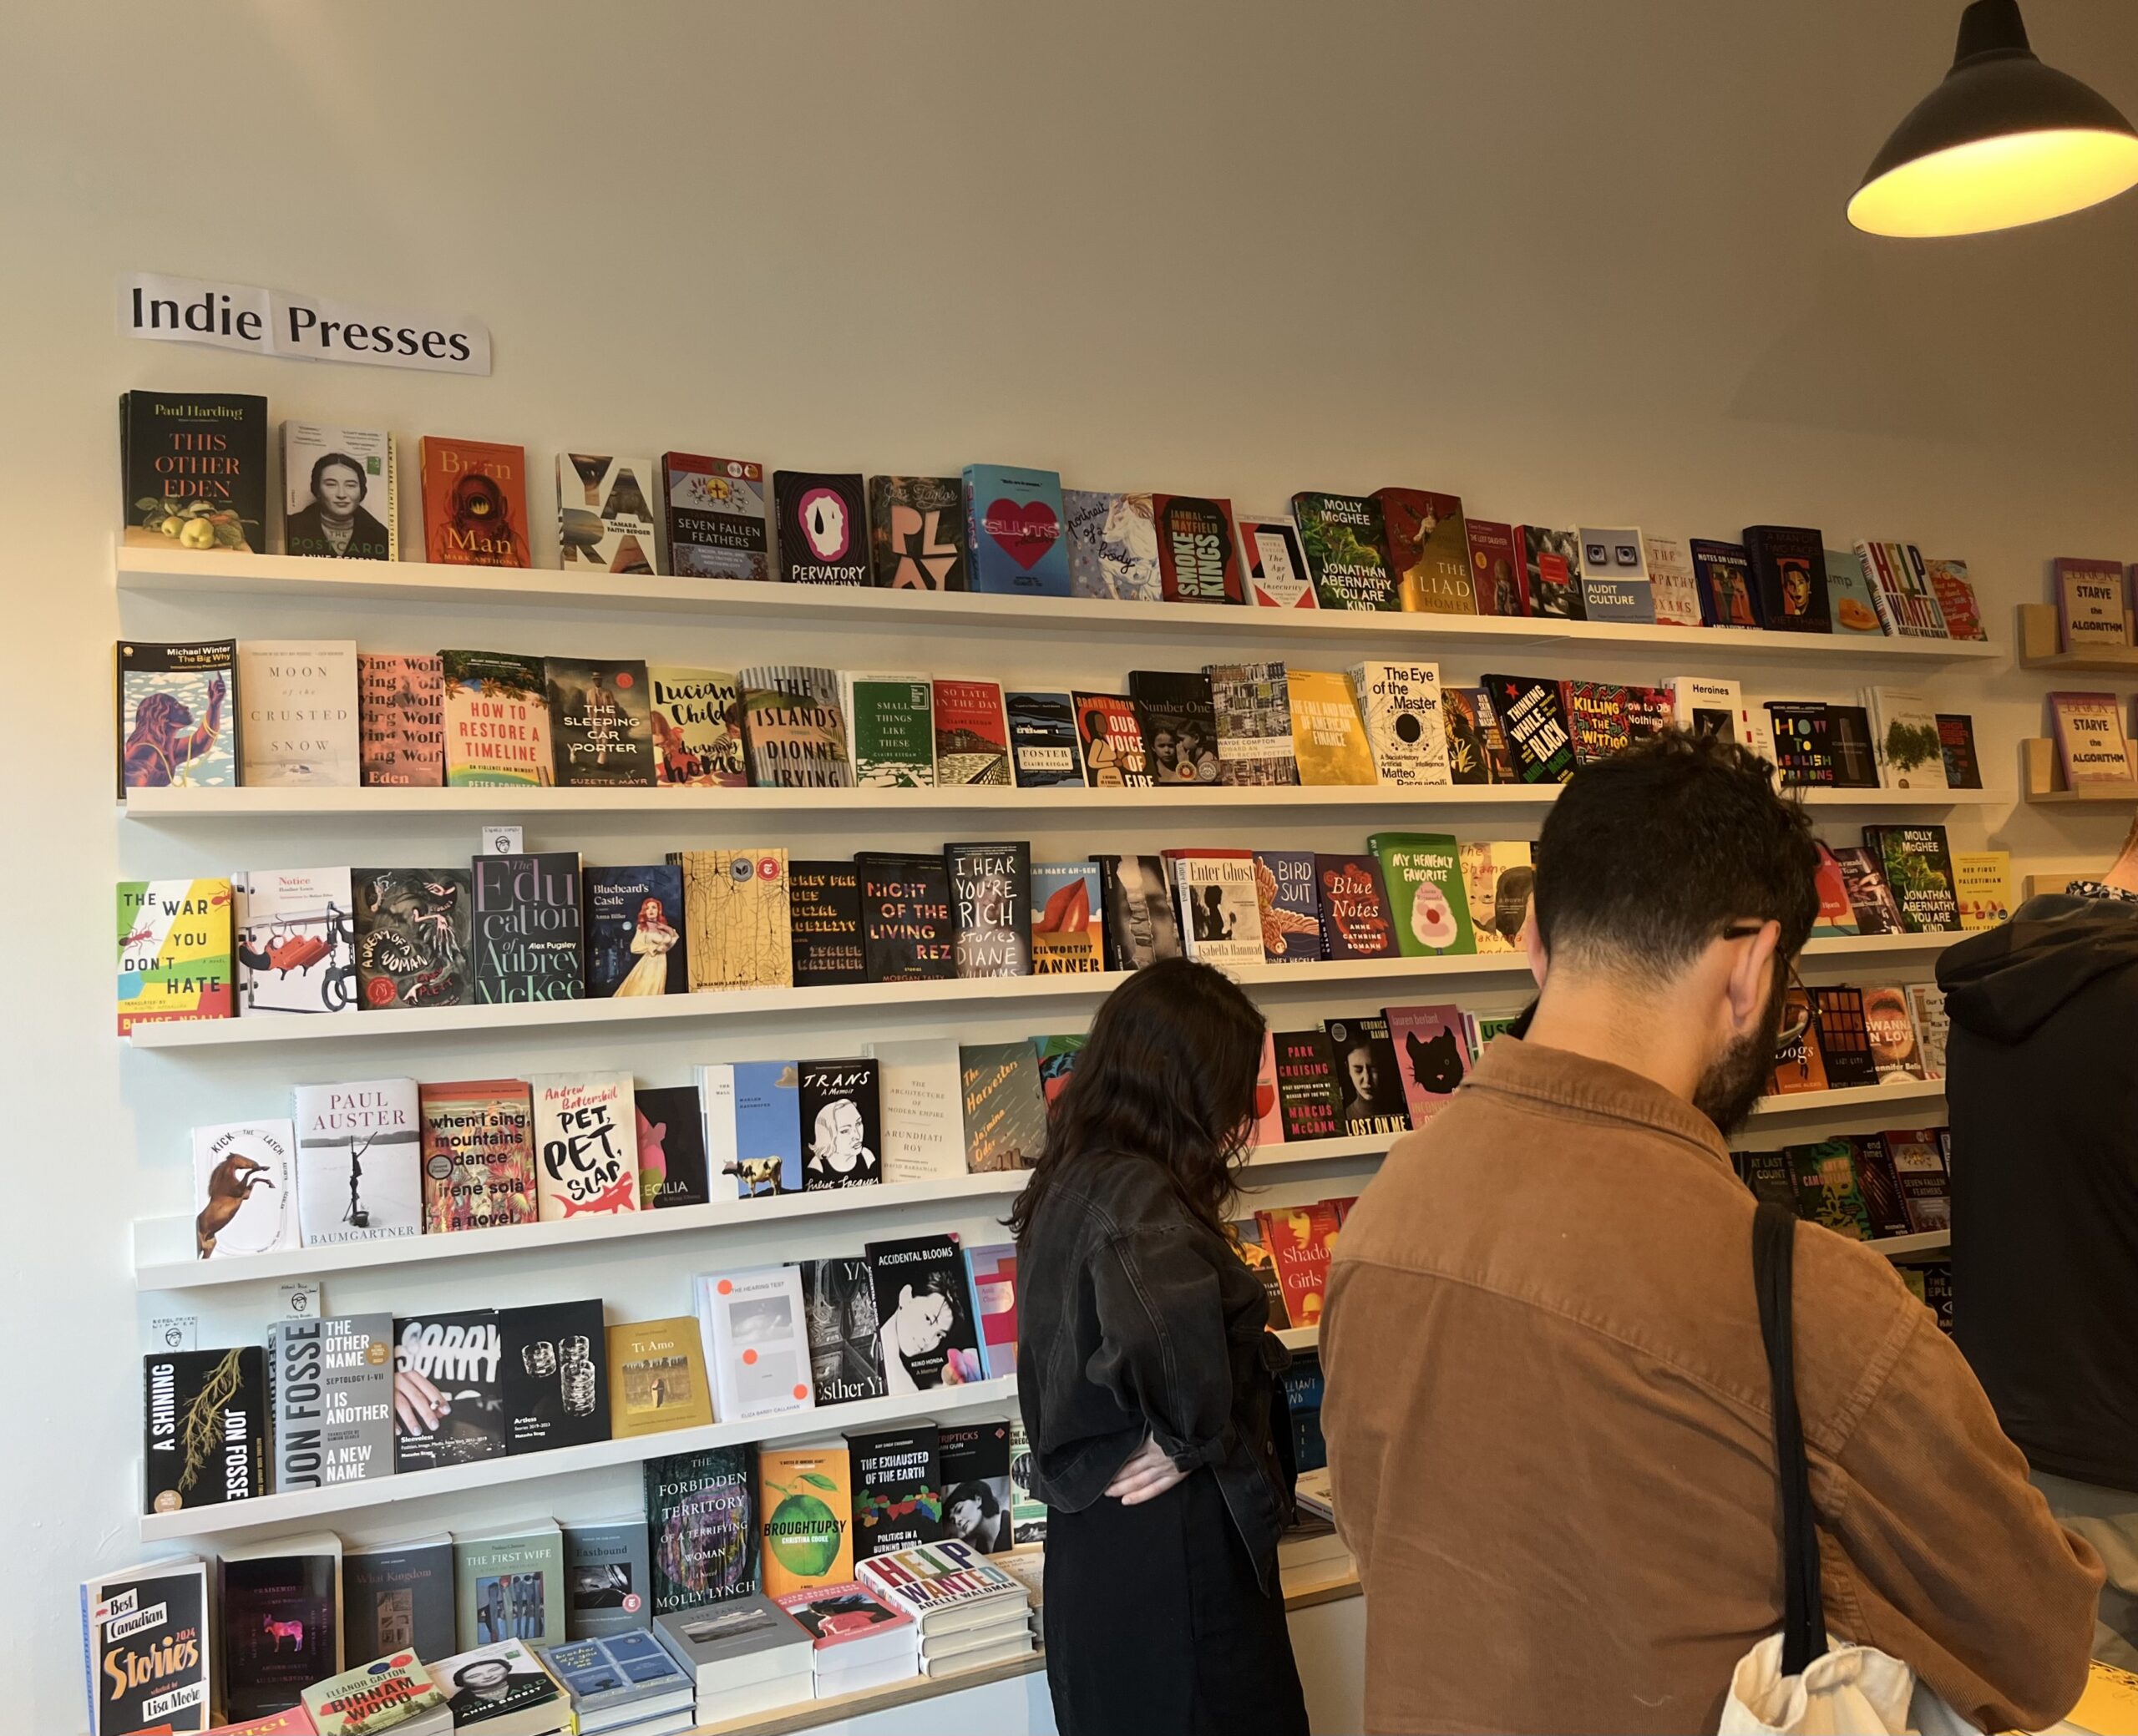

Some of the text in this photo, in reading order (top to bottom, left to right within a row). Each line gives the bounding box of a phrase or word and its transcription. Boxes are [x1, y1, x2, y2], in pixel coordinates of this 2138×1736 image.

[132, 287, 471, 362] Indie Presses
[155, 404, 244, 421] Paul Harding
[170, 433, 227, 452] THIS
[155, 456, 241, 475] OTHER
[165, 480, 231, 498] EDEN
[1324, 499, 1362, 513] MOLLY
[610, 520, 638, 529] TAMARA
[1171, 519, 1218, 534] MAYFIELD
[1320, 511, 1370, 525] McGHEE
[606, 526, 651, 535] FAITH BERGER
[677, 517, 762, 537] SEVEN FALLEN
[291, 536, 386, 554] POSTCARD
[447, 527, 513, 554] Man
[692, 531, 749, 548] FEATHERS
[443, 553, 520, 566] MARK ANTHONY
[1172, 531, 1199, 596] SMOKE
[1194, 534, 1225, 596] KINGS
[1697, 553, 1748, 567] NOTES LOVING
[792, 565, 866, 581] PERVATORY
[1322, 563, 1386, 579] JONATHAN
[1436, 561, 1467, 576] THE
[1263, 582, 1303, 592] Insecurity
[1320, 575, 1392, 590] ABERNATHY
[1587, 584, 1617, 595] AUDIT
[1331, 587, 1386, 601] YOU ARE
[1588, 595, 1635, 605] CULTURE
[2076, 585, 2112, 600] STARVE
[1424, 598, 1471, 611] HOMER
[2090, 607, 2103, 615] the
[2071, 620, 2123, 633] ALGORITHM
[269, 666, 327, 678] MOON
[1383, 666, 1435, 683] The Eye
[299, 687, 316, 696] the
[654, 681, 736, 706] Lucian
[773, 678, 811, 698] THE
[1388, 682, 1409, 696] the
[1692, 683, 1730, 696] Heroines
[470, 701, 527, 720] HOW TO
[584, 704, 616, 714] THE
[1139, 700, 1184, 713] Number
[1393, 696, 1436, 711] Master
[1573, 696, 1620, 716] KILLING
[251, 710, 348, 722] CRUSTED
[563, 716, 641, 727] SLEEPING
[671, 700, 731, 726] Child
[756, 708, 838, 728] ISLANDS
[875, 714, 913, 723] THINGS
[459, 721, 526, 741] RESTORE
[1109, 716, 1137, 734] OUR
[2073, 718, 2110, 731] STARVE
[586, 731, 621, 741] CAR
[1106, 735, 1146, 753] VOICE
[1241, 737, 1276, 746] COMPTON
[1581, 729, 1629, 750] WITTIGO
[2089, 738, 2102, 747] the
[271, 741, 329, 752] SNOW
[465, 741, 537, 762] TIMELINE
[571, 742, 637, 754] PORTER
[766, 740, 838, 762] DIONNE
[1021, 748, 1069, 759] FOSTER
[1127, 756, 1144, 773] OF
[2072, 752, 2125, 763] ALGORITHM
[368, 770, 410, 784] Eden
[618, 777, 649, 786] MAYR
[773, 769, 840, 787] IRVING
[1381, 767, 1416, 779] Matteo
[1904, 831, 1933, 842] MOLLY
[973, 856, 1016, 875] HEAR
[1278, 860, 1312, 881] BIRD
[278, 876, 311, 886] Notice
[1404, 868, 1448, 882] FAVORITE
[1958, 877, 2003, 885] PALESTINIAN
[593, 883, 650, 894] Bluebeard's
[867, 883, 927, 898] NIGHT
[955, 879, 1017, 900] YOU'RE
[1280, 883, 1312, 903] SUIT
[1332, 877, 1372, 895] Blue
[593, 895, 625, 906] Castle
[1903, 889, 1952, 901] JONATHAN
[124, 893, 208, 916] THE WAR
[1331, 900, 1379, 918] Notes
[958, 900, 1014, 929] RICH
[173, 933, 208, 947] YOU
[869, 924, 935, 940] LIVING
[917, 944, 952, 959] REZ
[956, 946, 1018, 966] DIANE
[124, 956, 175, 972] DON'T
[167, 976, 221, 995] HATE
[1287, 1045, 1315, 1059] PARK
[1279, 1063, 1329, 1077] CRUISING
[803, 1070, 870, 1089] TRANS
[966, 1060, 1018, 1115] Harvesters
[330, 1091, 389, 1110] PAUL
[1288, 1103, 1333, 1119] MARCUS
[312, 1109, 407, 1131] AUSTER
[428, 1113, 476, 1130] when
[1345, 1117, 1372, 1136] LOST
[434, 1131, 524, 1148] mountains
[884, 1130, 943, 1143] ARUNDHATI
[453, 1151, 508, 1167] dance
[438, 1181, 484, 1197] irene
[466, 1211, 514, 1227] novel
[310, 1225, 415, 1245] BAUMGARTNER
[878, 1250, 922, 1267] ACCIDENTAL
[742, 1283, 770, 1293] HEARING
[1288, 1271, 1323, 1290] Girls
[325, 1319, 352, 1337] THE
[325, 1334, 370, 1353] OTHER
[647, 1340, 675, 1352] Amo
[325, 1351, 366, 1369] NAME
[325, 1374, 366, 1386] SEPTOLOGY
[152, 1362, 175, 1437] SHINING
[285, 1322, 322, 1488] JON FOSSE
[325, 1404, 390, 1425] ANOTHER
[773, 1404, 800, 1415] CALLAHAN
[339, 1445, 372, 1463] NEW
[879, 1450, 930, 1469] EXHAUSTED
[225, 1443, 250, 1501] FOSSE
[896, 1466, 925, 1481] EARTH
[658, 1471, 747, 1497] FORBIDDEN
[661, 1495, 745, 1520] TERRITORY
[686, 1521, 748, 1539] TERRIFYING
[763, 1520, 847, 1537] BROUGHTUPSY
[782, 1535, 829, 1545] CHRISTINA COOKE
[491, 1548, 552, 1565] FIRST WIFE
[864, 1541, 975, 1588] HELP
[894, 1566, 1010, 1604] WANTED
[656, 1580, 756, 1609] MOLLY LYNCH
[109, 1595, 134, 1616] Best
[109, 1607, 165, 1638] Canadian
[103, 1636, 200, 1701] Stories
[170, 1688, 201, 1708] Moore
[329, 1676, 416, 1713] BIRNAM
[346, 1692, 413, 1722] WOOD
